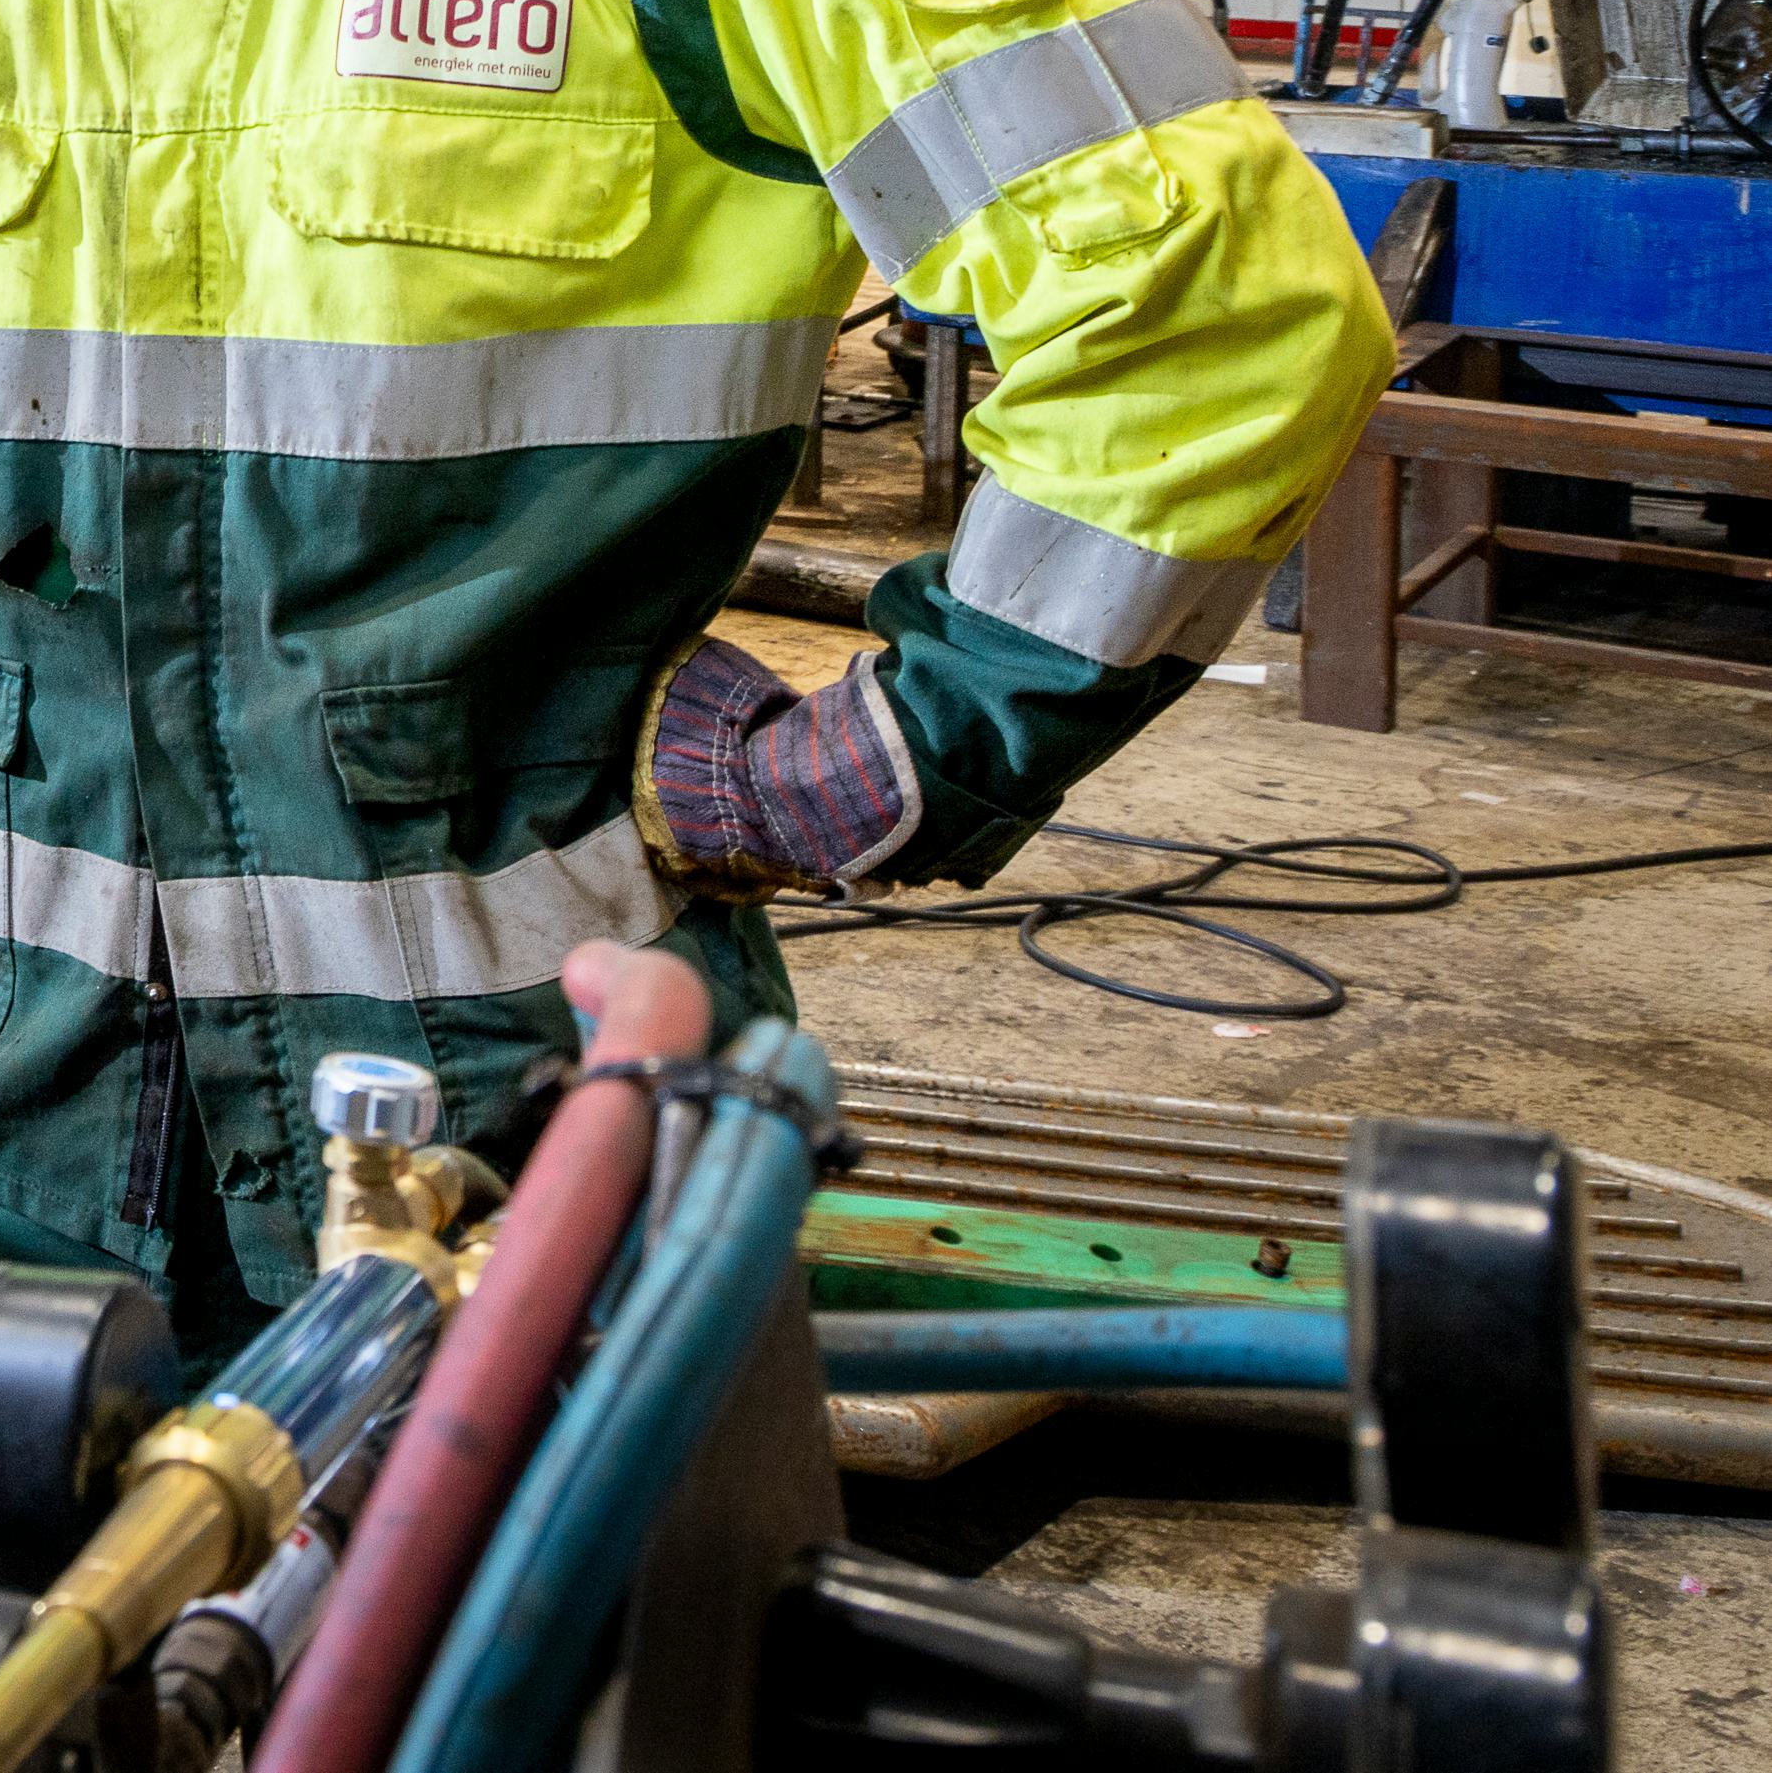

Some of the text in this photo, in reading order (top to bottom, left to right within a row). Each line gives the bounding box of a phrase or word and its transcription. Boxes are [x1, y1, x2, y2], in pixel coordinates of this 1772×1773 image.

[413, 54, 552, 79] energiek met milieu
